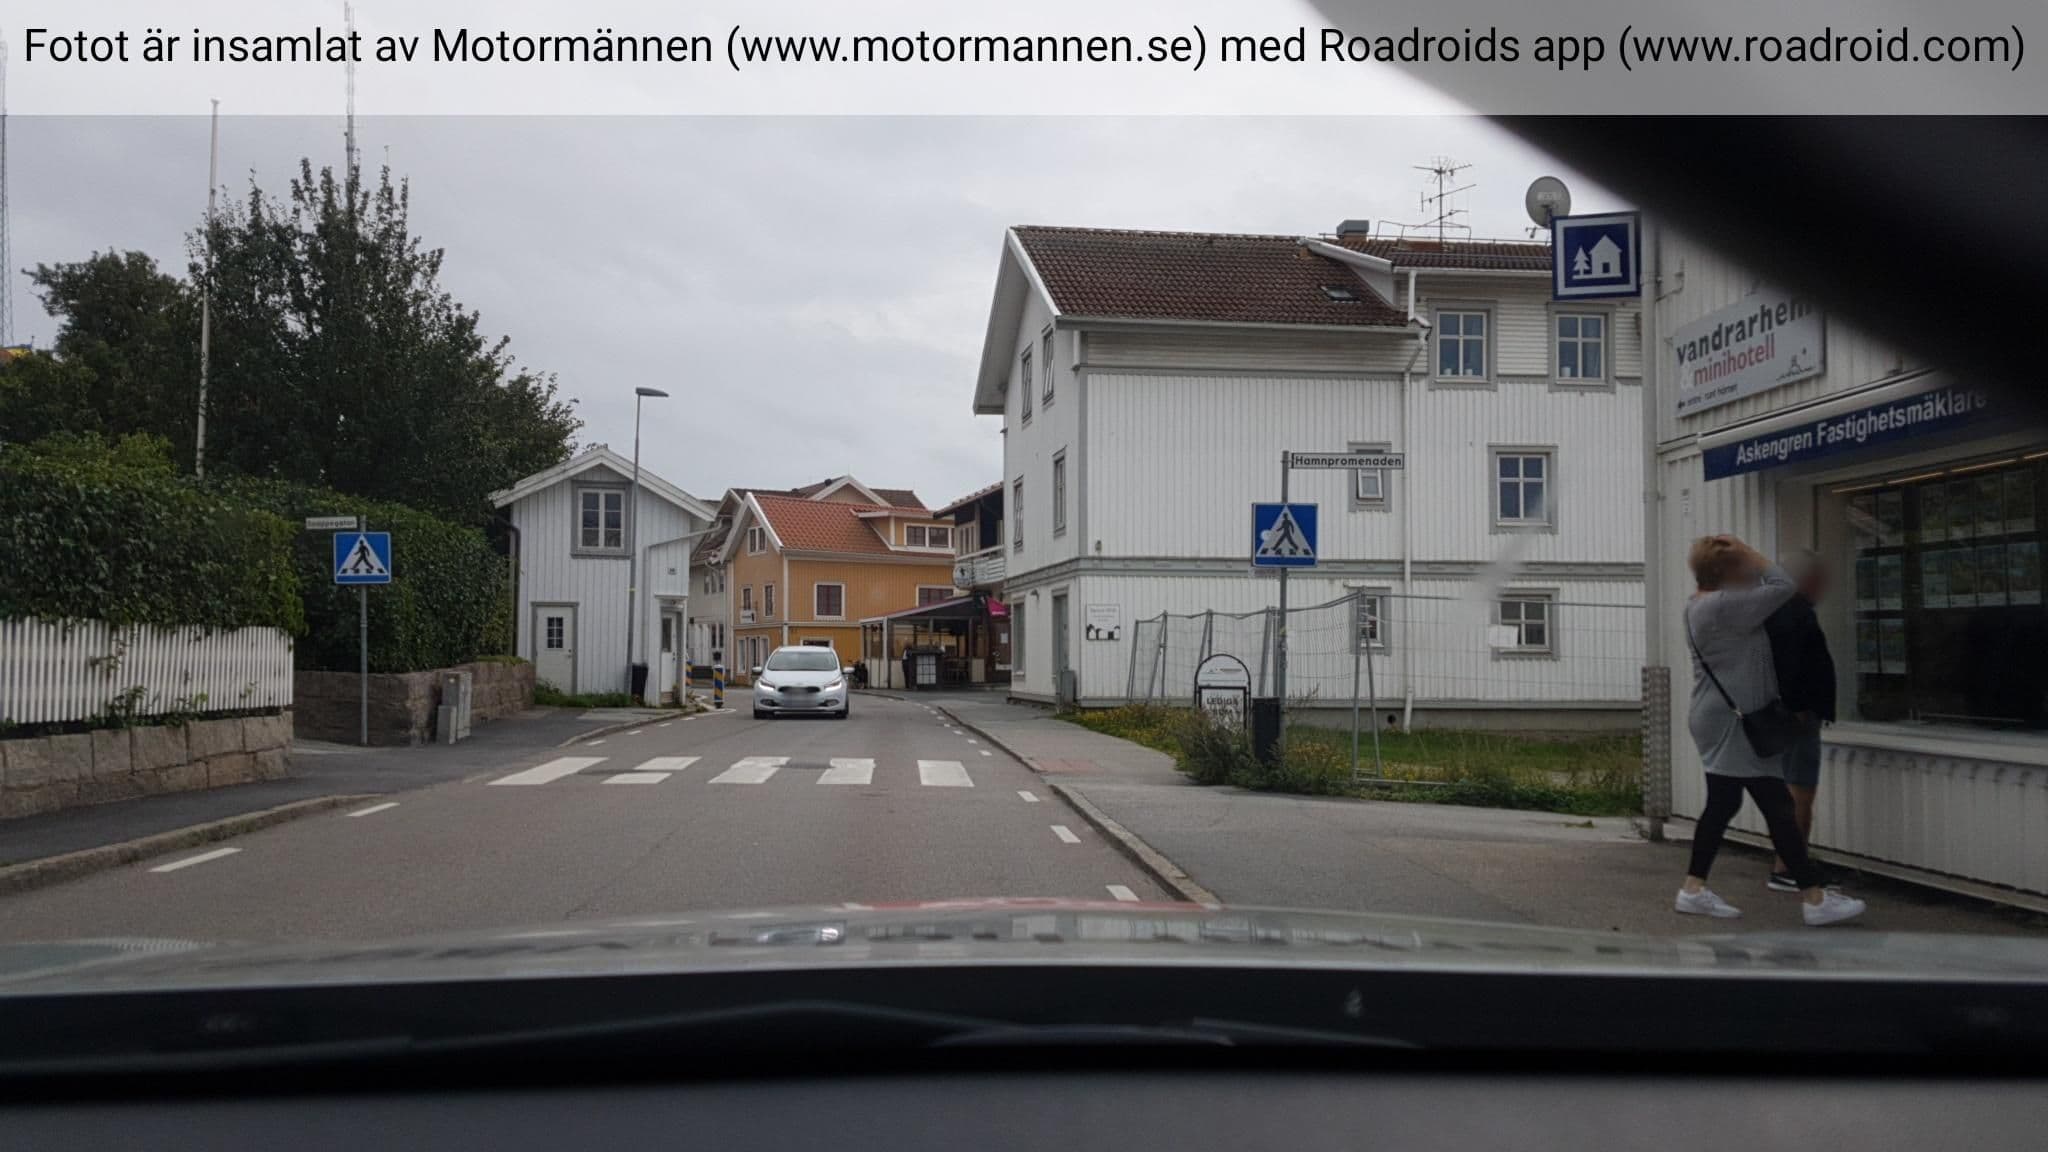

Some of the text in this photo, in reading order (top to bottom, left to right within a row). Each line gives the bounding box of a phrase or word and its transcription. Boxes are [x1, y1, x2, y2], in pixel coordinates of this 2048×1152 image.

[1694, 333, 1776, 385] minihotell
[1735, 389, 1988, 466] Askengren Fastighetsmäklare
[1295, 454, 1402, 469] Hamnpromenaden
